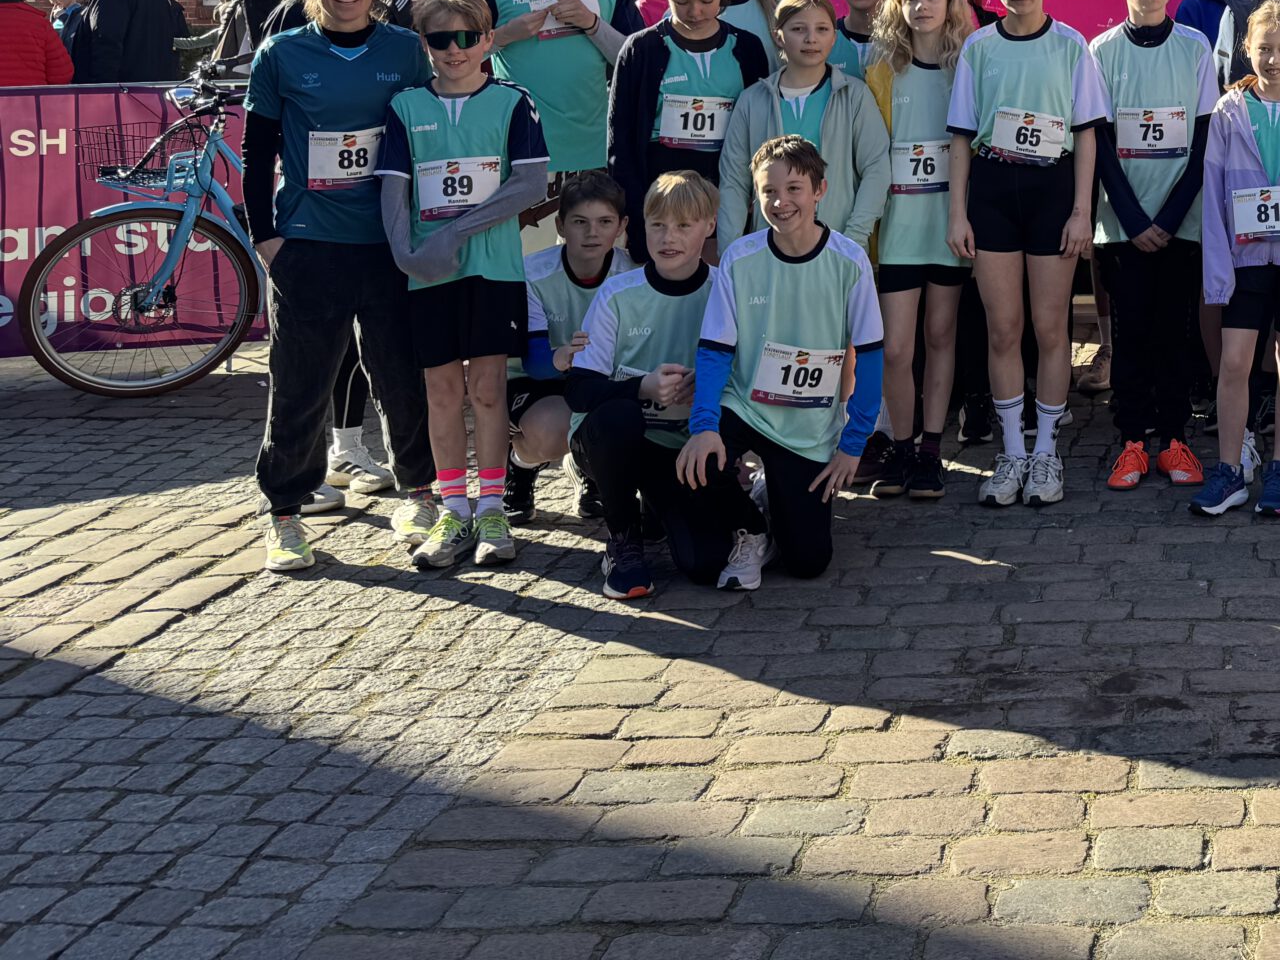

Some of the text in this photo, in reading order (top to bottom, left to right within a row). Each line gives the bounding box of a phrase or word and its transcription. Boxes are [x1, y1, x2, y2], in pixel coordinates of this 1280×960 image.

[376, 72, 401, 81] Huth
[680, 112, 715, 131] 101
[1015, 126, 1041, 147] 65
[1139, 123, 1164, 142] 75
[9, 129, 67, 157] SH
[338, 147, 369, 170] 88
[909, 157, 936, 177] 76
[442, 175, 473, 197] 89
[1257, 203, 1280, 223] 81
[781, 364, 823, 388] 109
